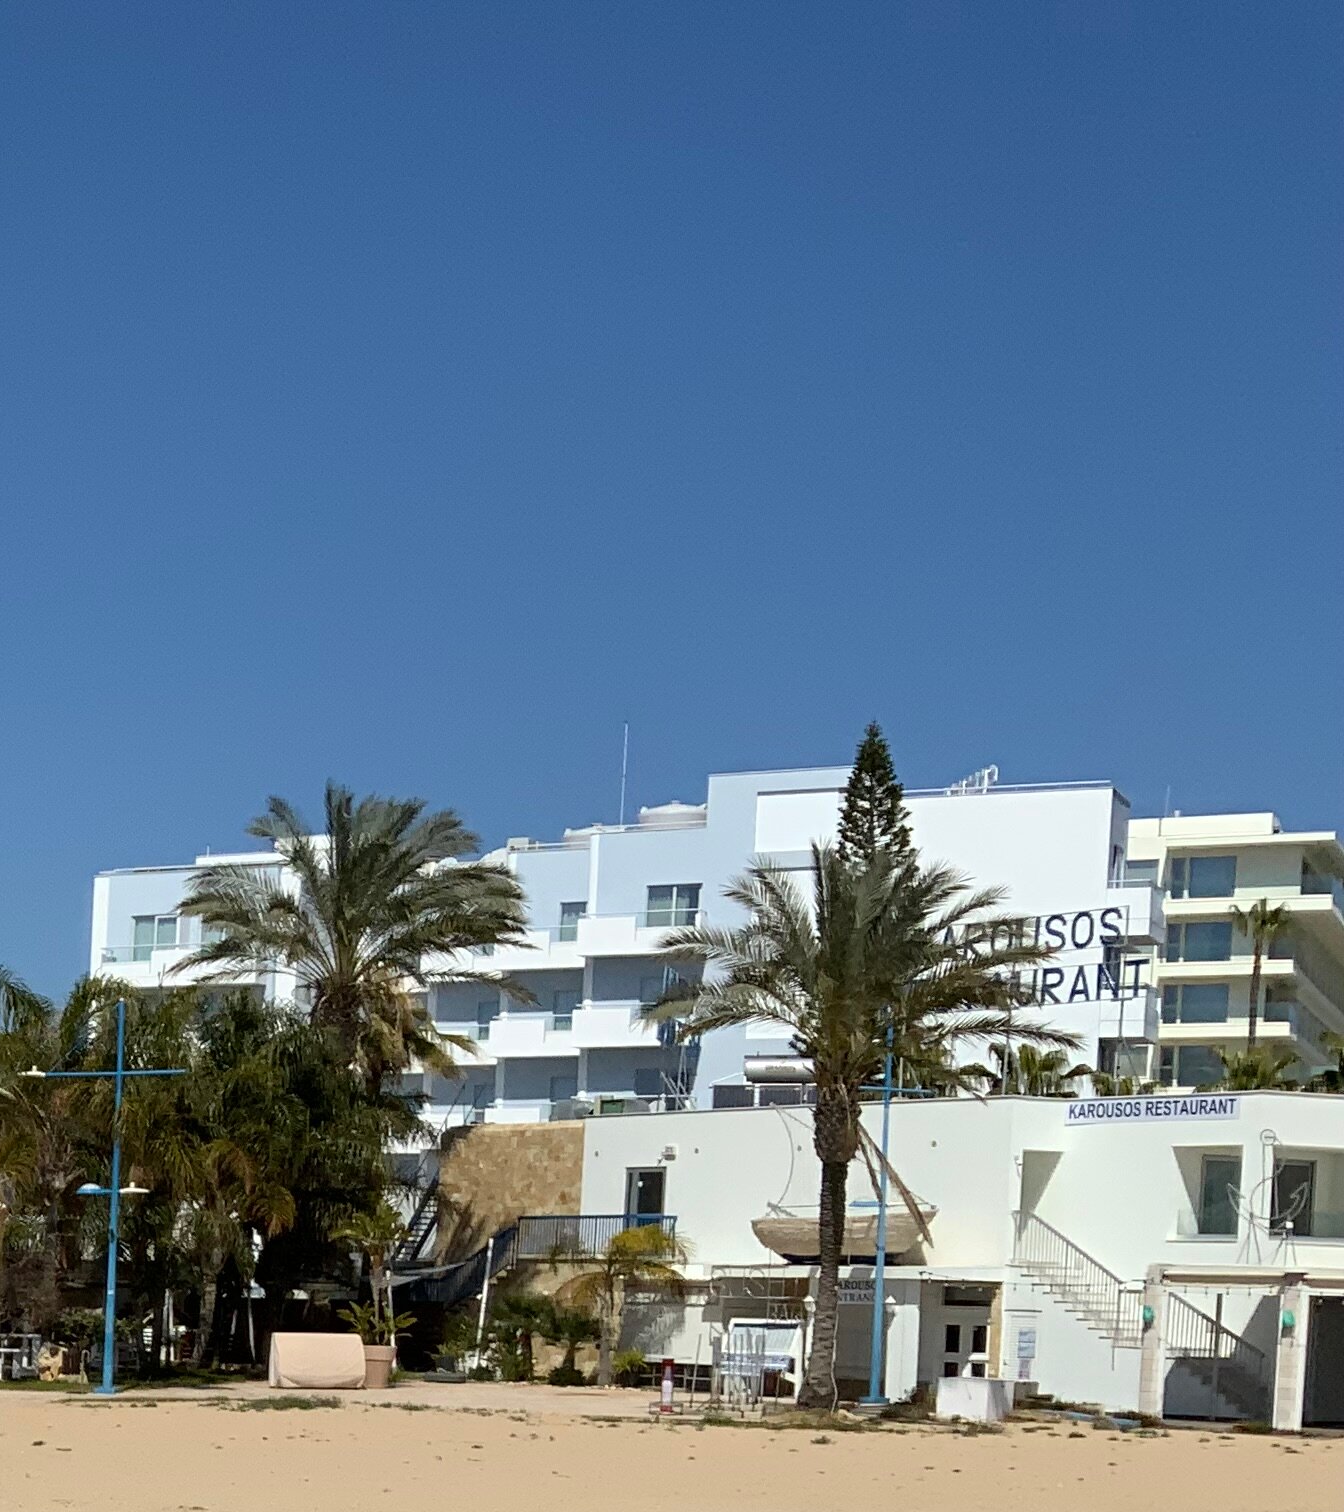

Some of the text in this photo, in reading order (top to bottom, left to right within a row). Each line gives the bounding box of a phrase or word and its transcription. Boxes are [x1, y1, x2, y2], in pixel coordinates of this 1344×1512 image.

[942, 907, 1123, 962] AROUSOS
[1068, 1098, 1237, 1119] KAROUSOS RESTAURANT
